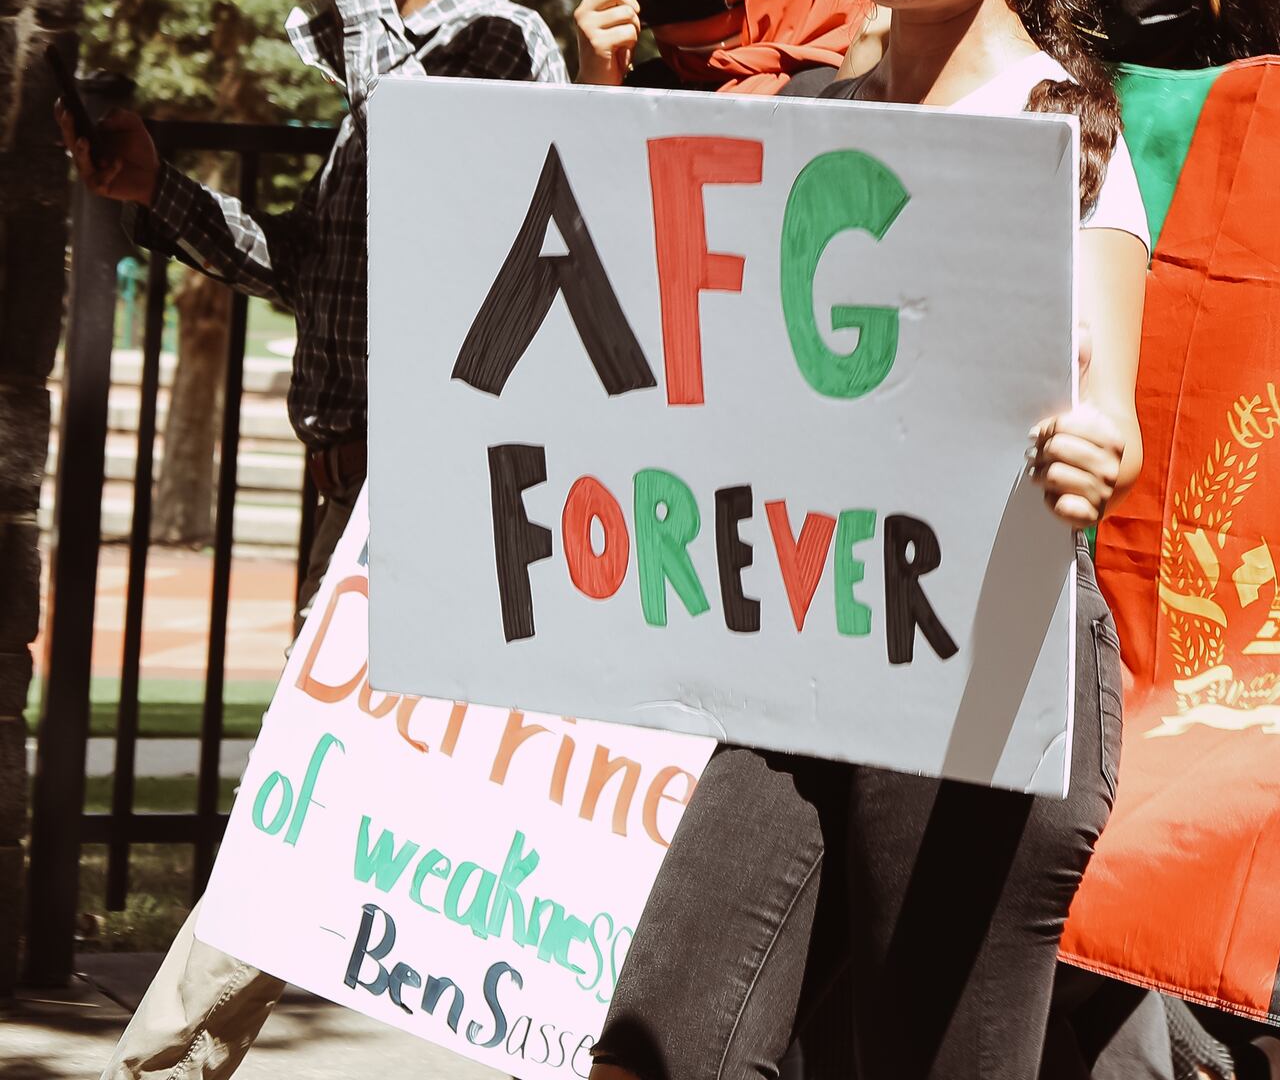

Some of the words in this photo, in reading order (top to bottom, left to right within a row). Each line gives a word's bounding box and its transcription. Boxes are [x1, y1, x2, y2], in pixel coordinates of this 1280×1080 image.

[450, 133, 912, 407] AFG
[486, 441, 961, 666] FOREVER
[250, 732, 346, 848] of
[352, 814, 633, 1004] weakness
